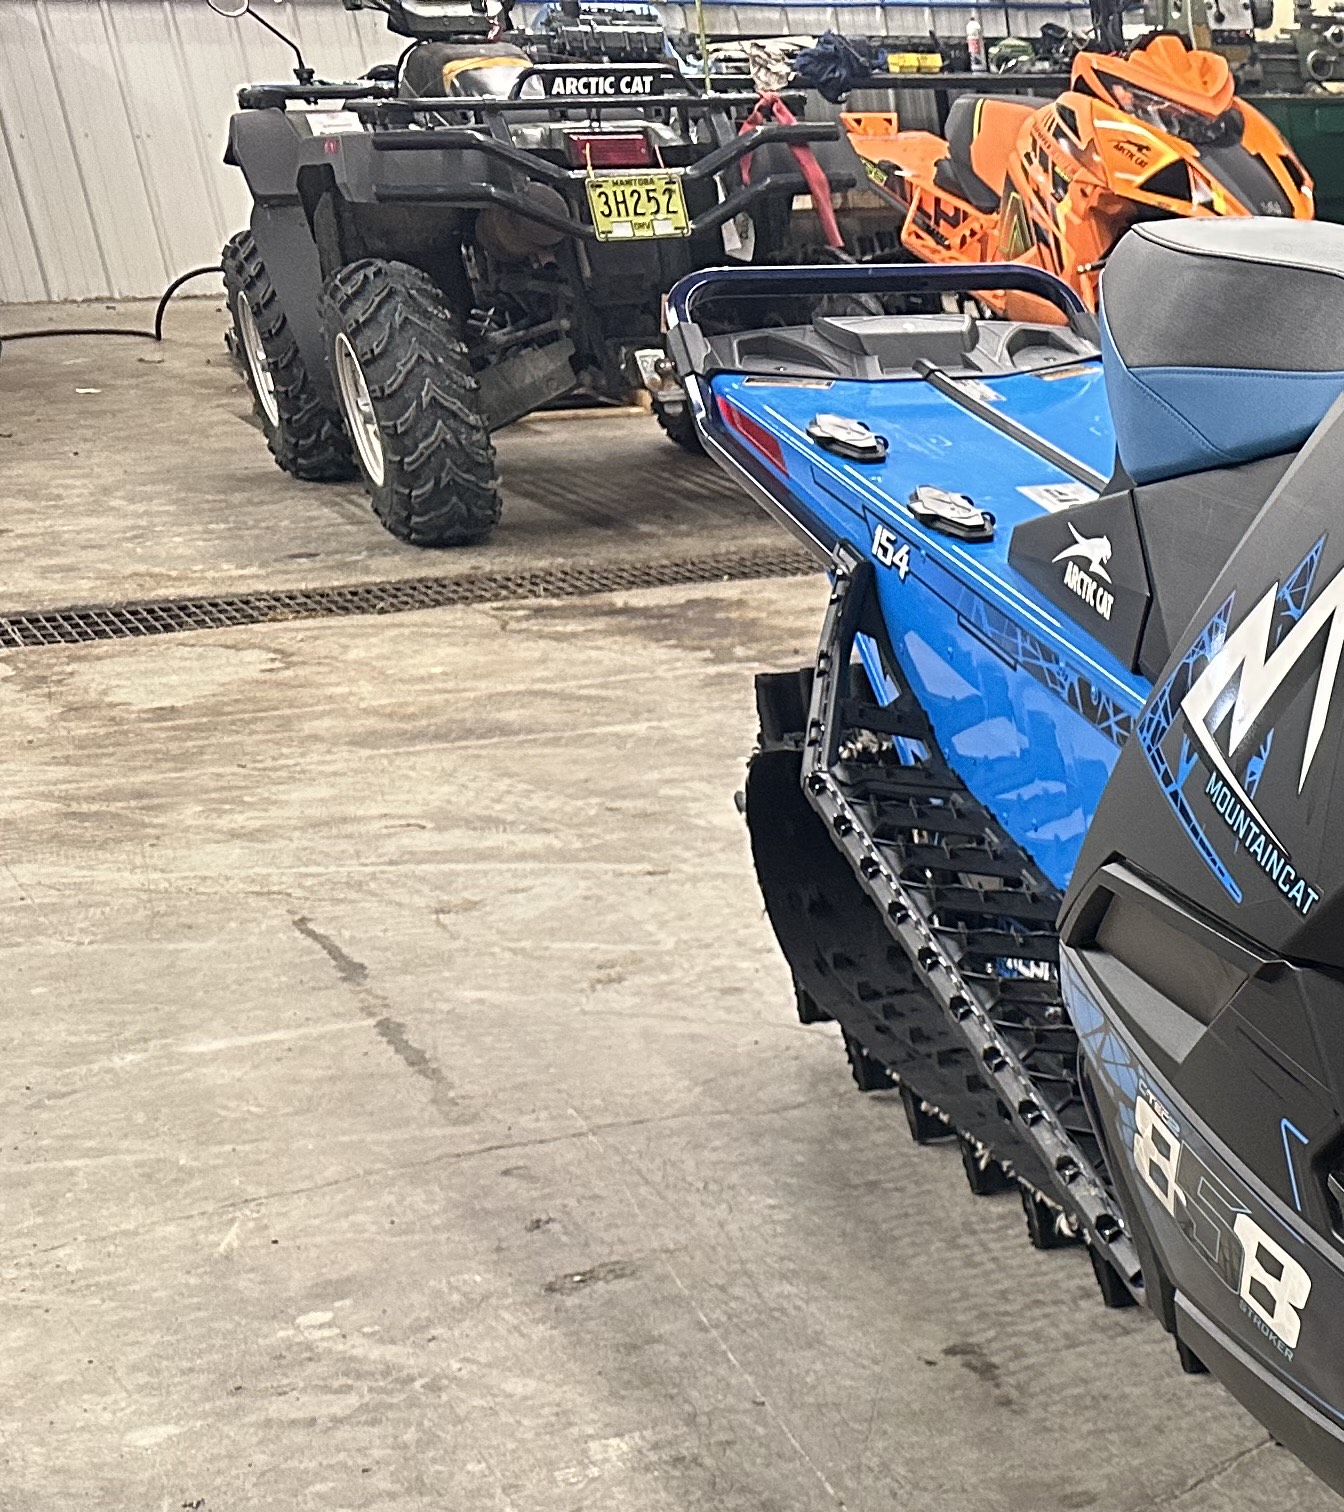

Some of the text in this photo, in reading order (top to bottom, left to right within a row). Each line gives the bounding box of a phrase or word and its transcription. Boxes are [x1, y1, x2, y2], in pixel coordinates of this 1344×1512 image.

[551, 75, 654, 95] ARCTIC CAT
[597, 188, 678, 218] 3H252
[871, 524, 910, 580] 154
[1064, 560, 1114, 620] ARCTIC CAT
[1205, 771, 1320, 915] MOUNTAINCAT
[1239, 1299, 1294, 1362] STROKER
